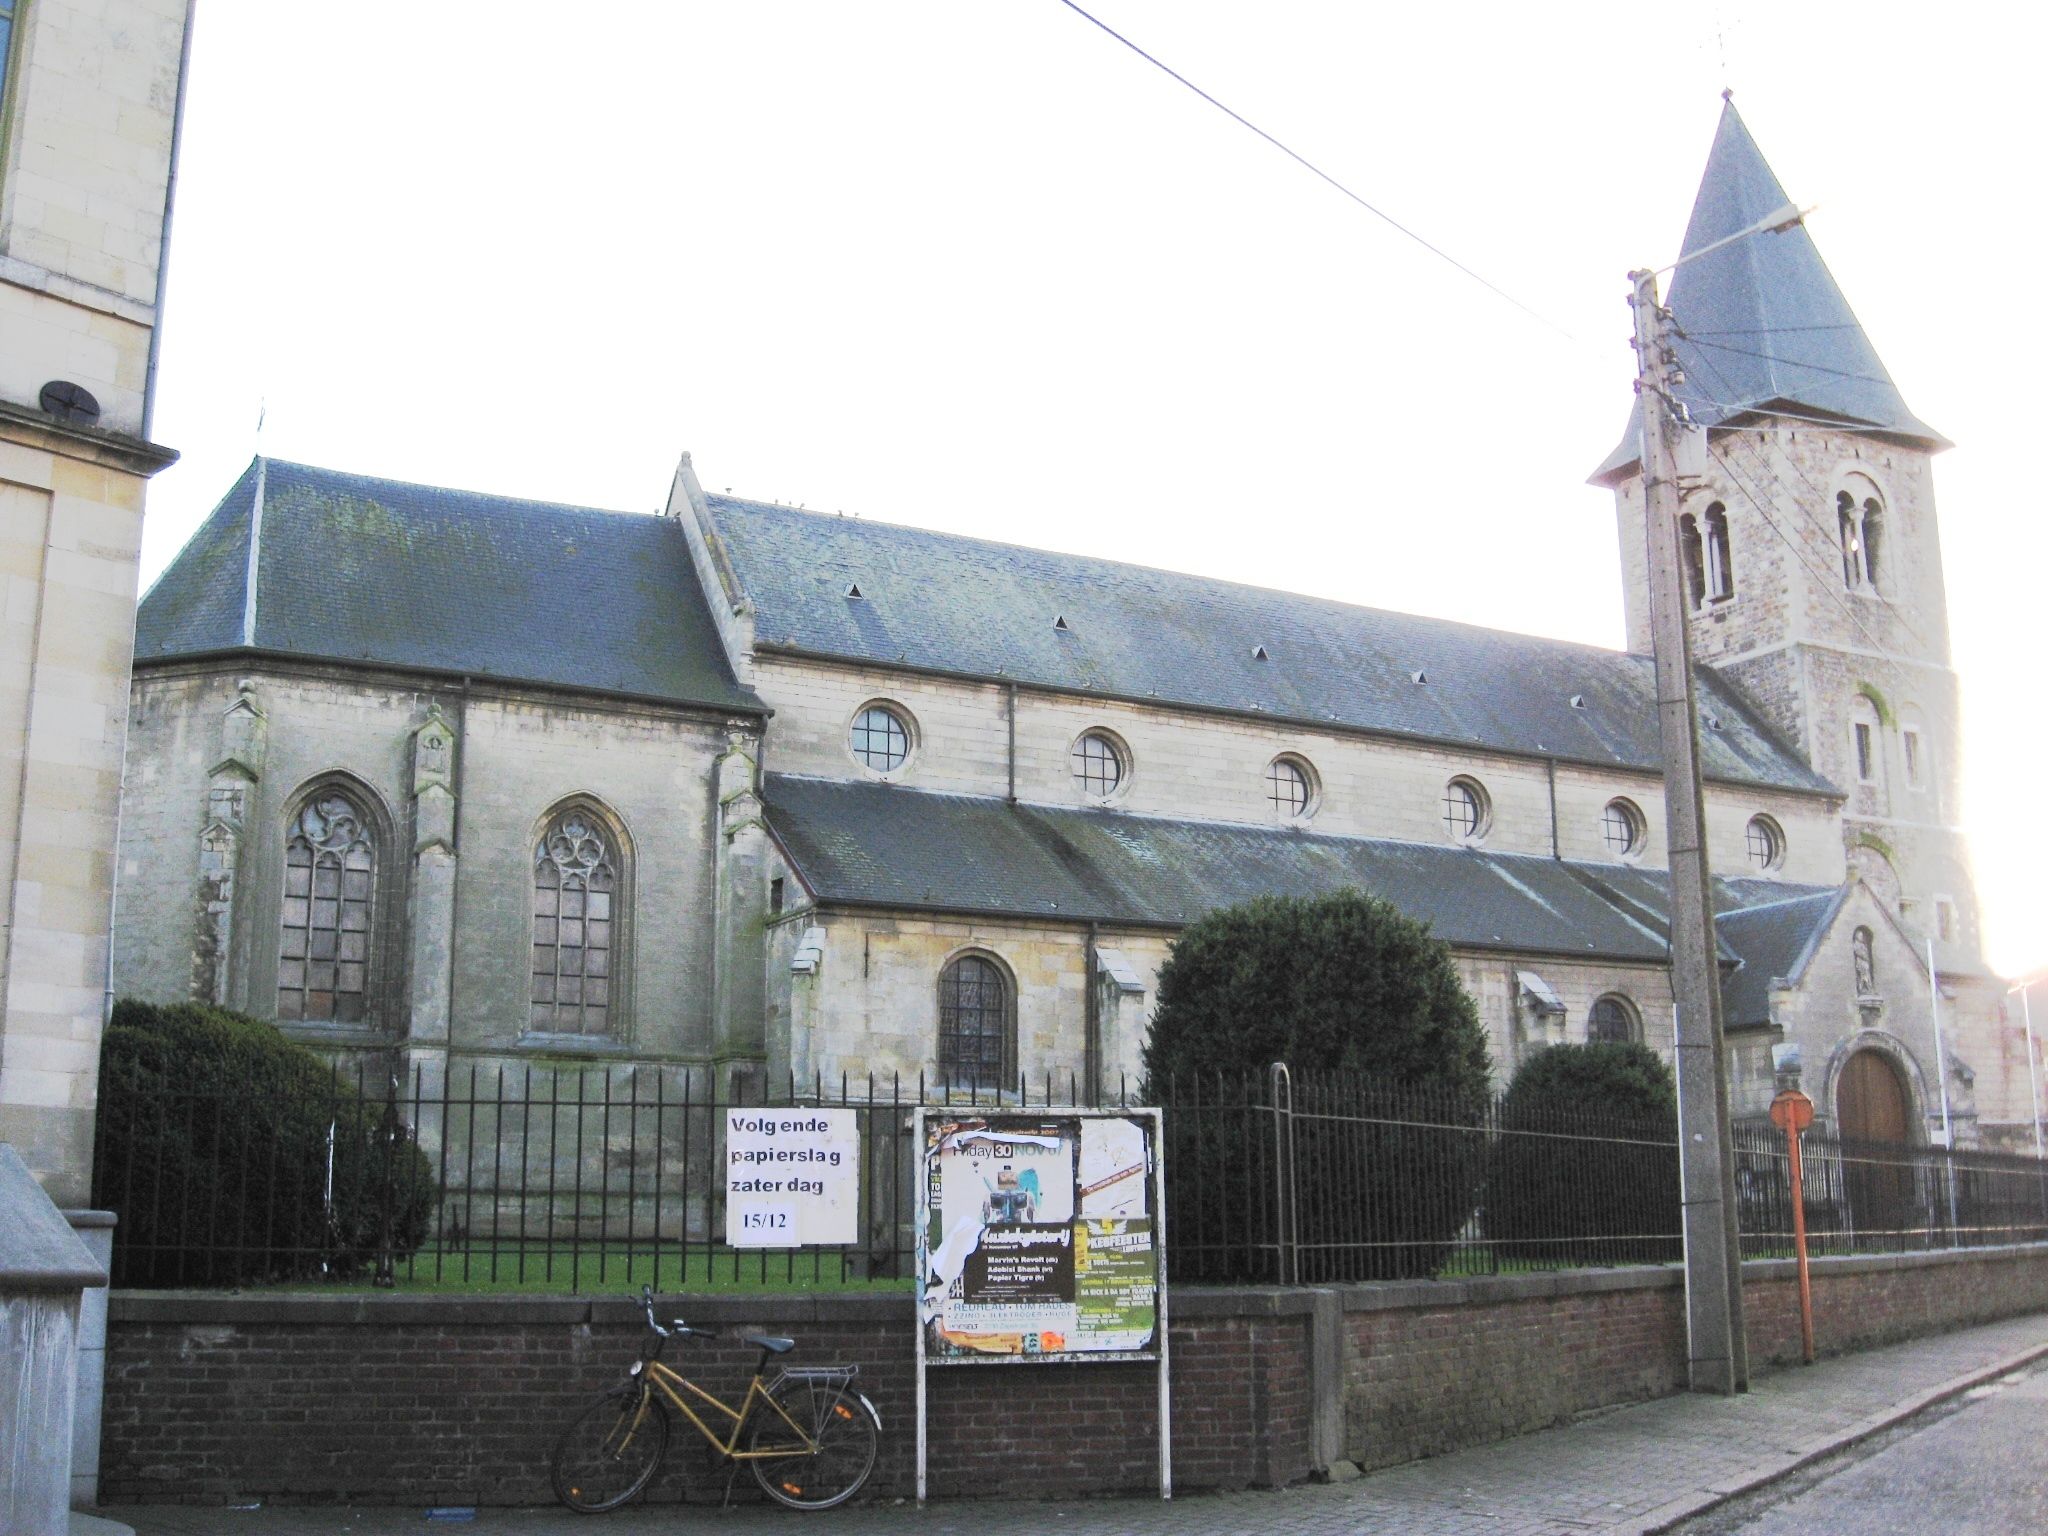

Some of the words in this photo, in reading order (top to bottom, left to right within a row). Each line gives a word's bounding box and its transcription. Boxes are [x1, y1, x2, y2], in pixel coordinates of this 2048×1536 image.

[994, 1144, 1012, 1158] 30
[743, 1213, 787, 1228] 15/12
[987, 1256, 1019, 1264] Marvin's
[1021, 1256, 1045, 1264] Revolt
